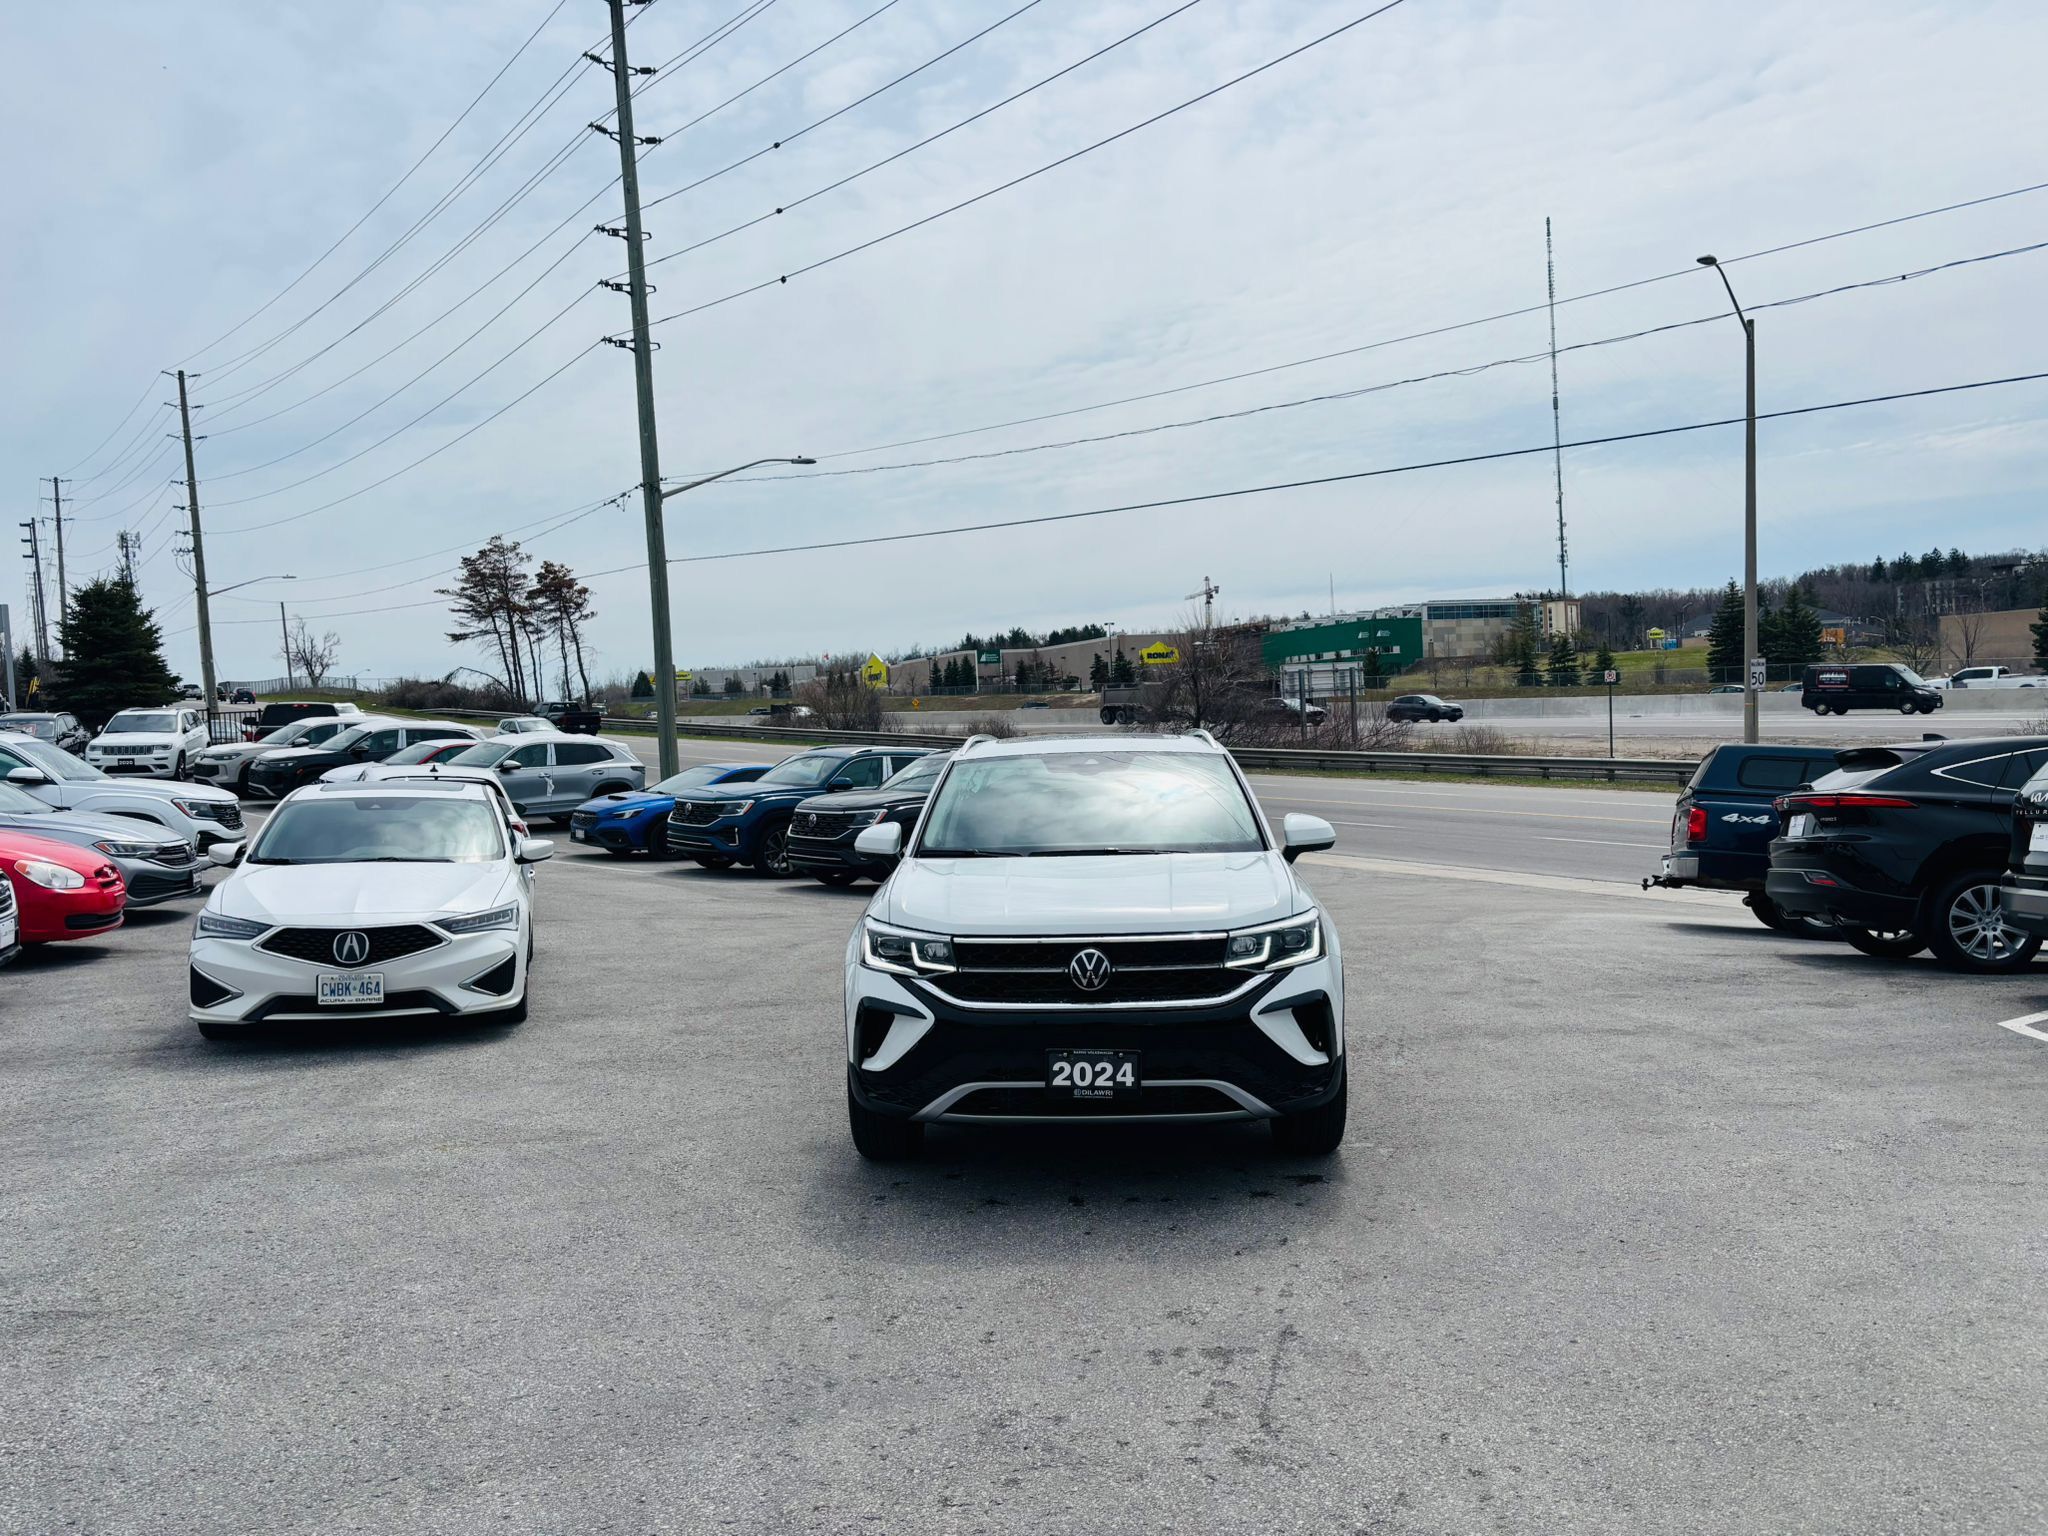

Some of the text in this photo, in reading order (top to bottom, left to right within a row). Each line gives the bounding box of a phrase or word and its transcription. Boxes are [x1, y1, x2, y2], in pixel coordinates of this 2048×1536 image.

[1751, 671, 1765, 686] 50
[321, 981, 381, 997] CWBK 464
[1052, 1061, 1135, 1087] 2024
